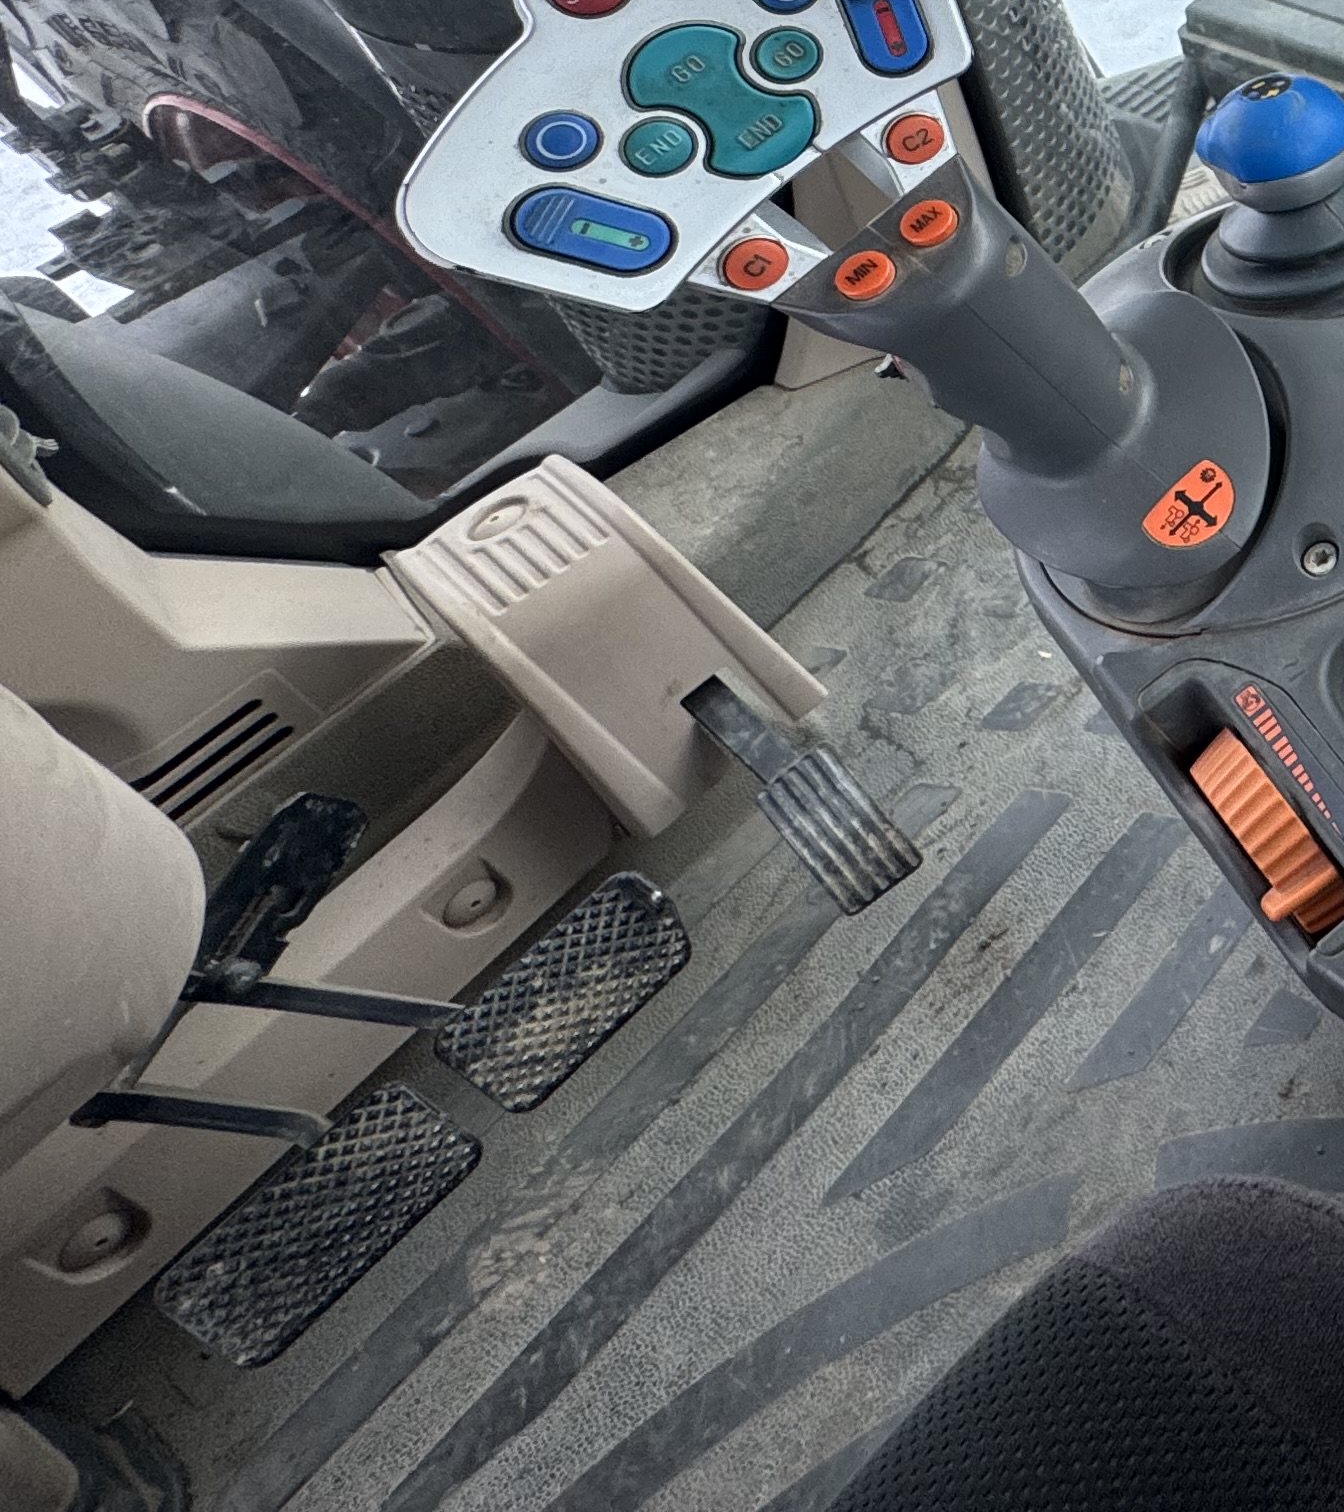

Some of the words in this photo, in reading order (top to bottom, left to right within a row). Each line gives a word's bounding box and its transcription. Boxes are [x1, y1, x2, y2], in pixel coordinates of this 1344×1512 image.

[671, 53, 706, 83] GO
[773, 41, 804, 68] GO
[736, 111, 783, 151] END
[902, 128, 931, 152] C2
[634, 129, 684, 166] END
[910, 207, 944, 233] MAX
[743, 252, 771, 278] C1
[845, 258, 877, 285] MIN
